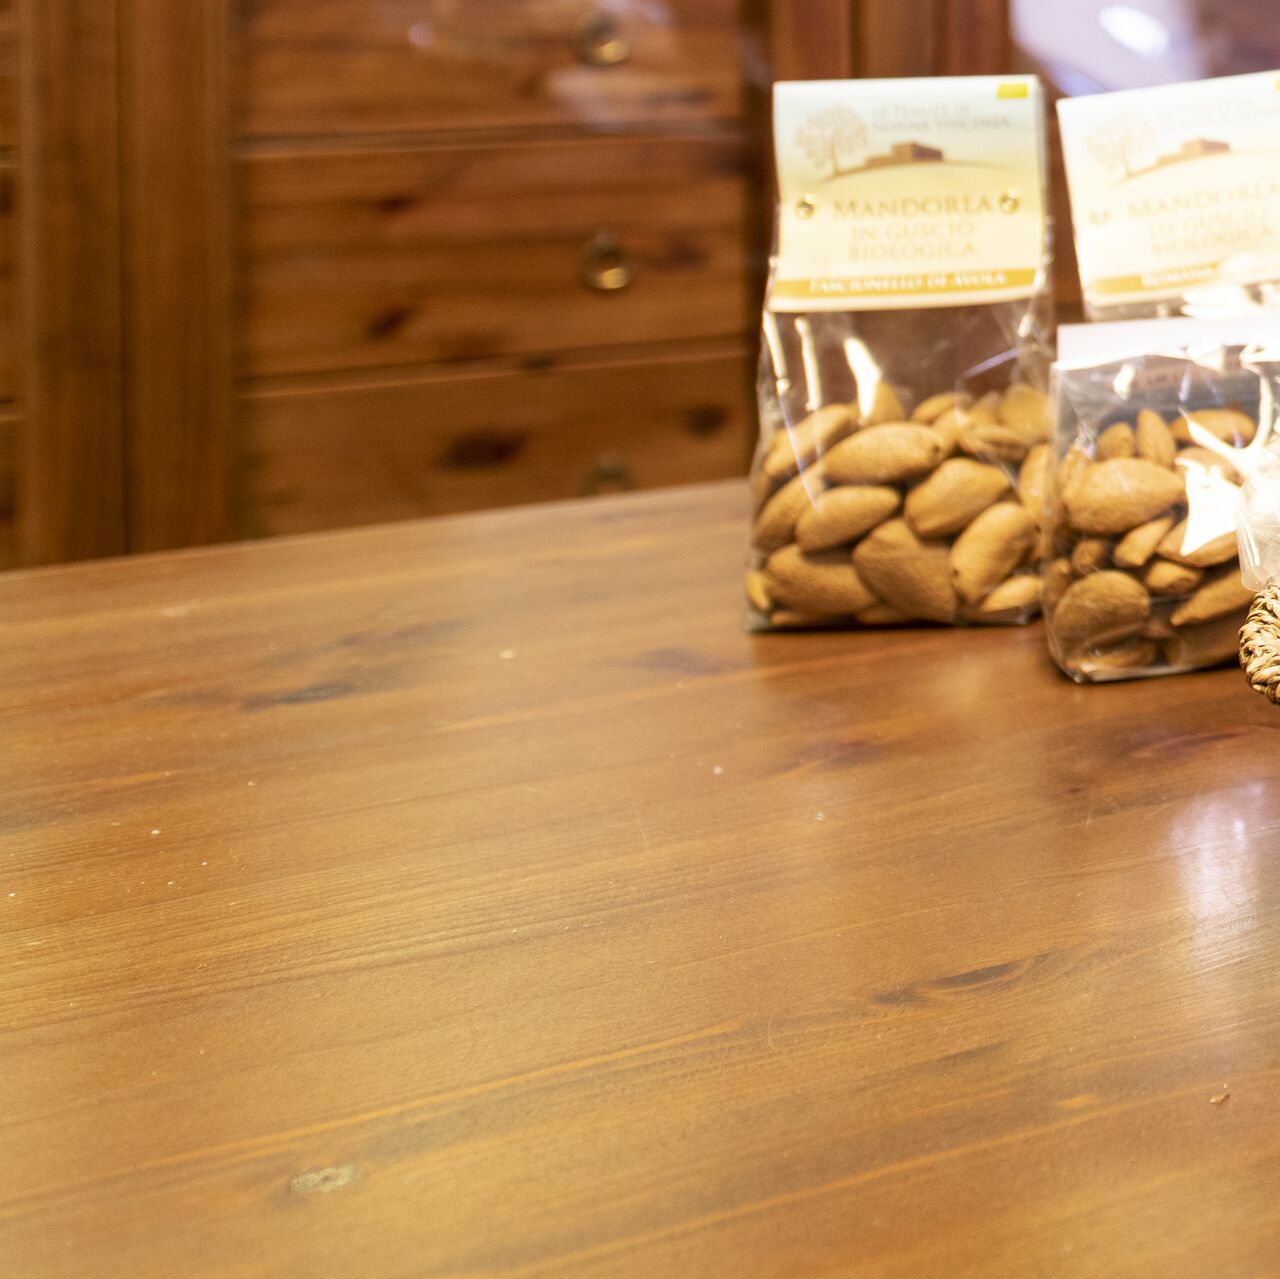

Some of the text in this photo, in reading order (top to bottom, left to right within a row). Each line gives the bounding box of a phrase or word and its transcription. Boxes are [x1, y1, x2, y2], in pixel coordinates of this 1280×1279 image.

[832, 192, 993, 221] MANDORLA
[1127, 182, 1280, 220] MANDORLA
[851, 224, 877, 241] IN
[848, 241, 976, 264] BIOLOGICA
